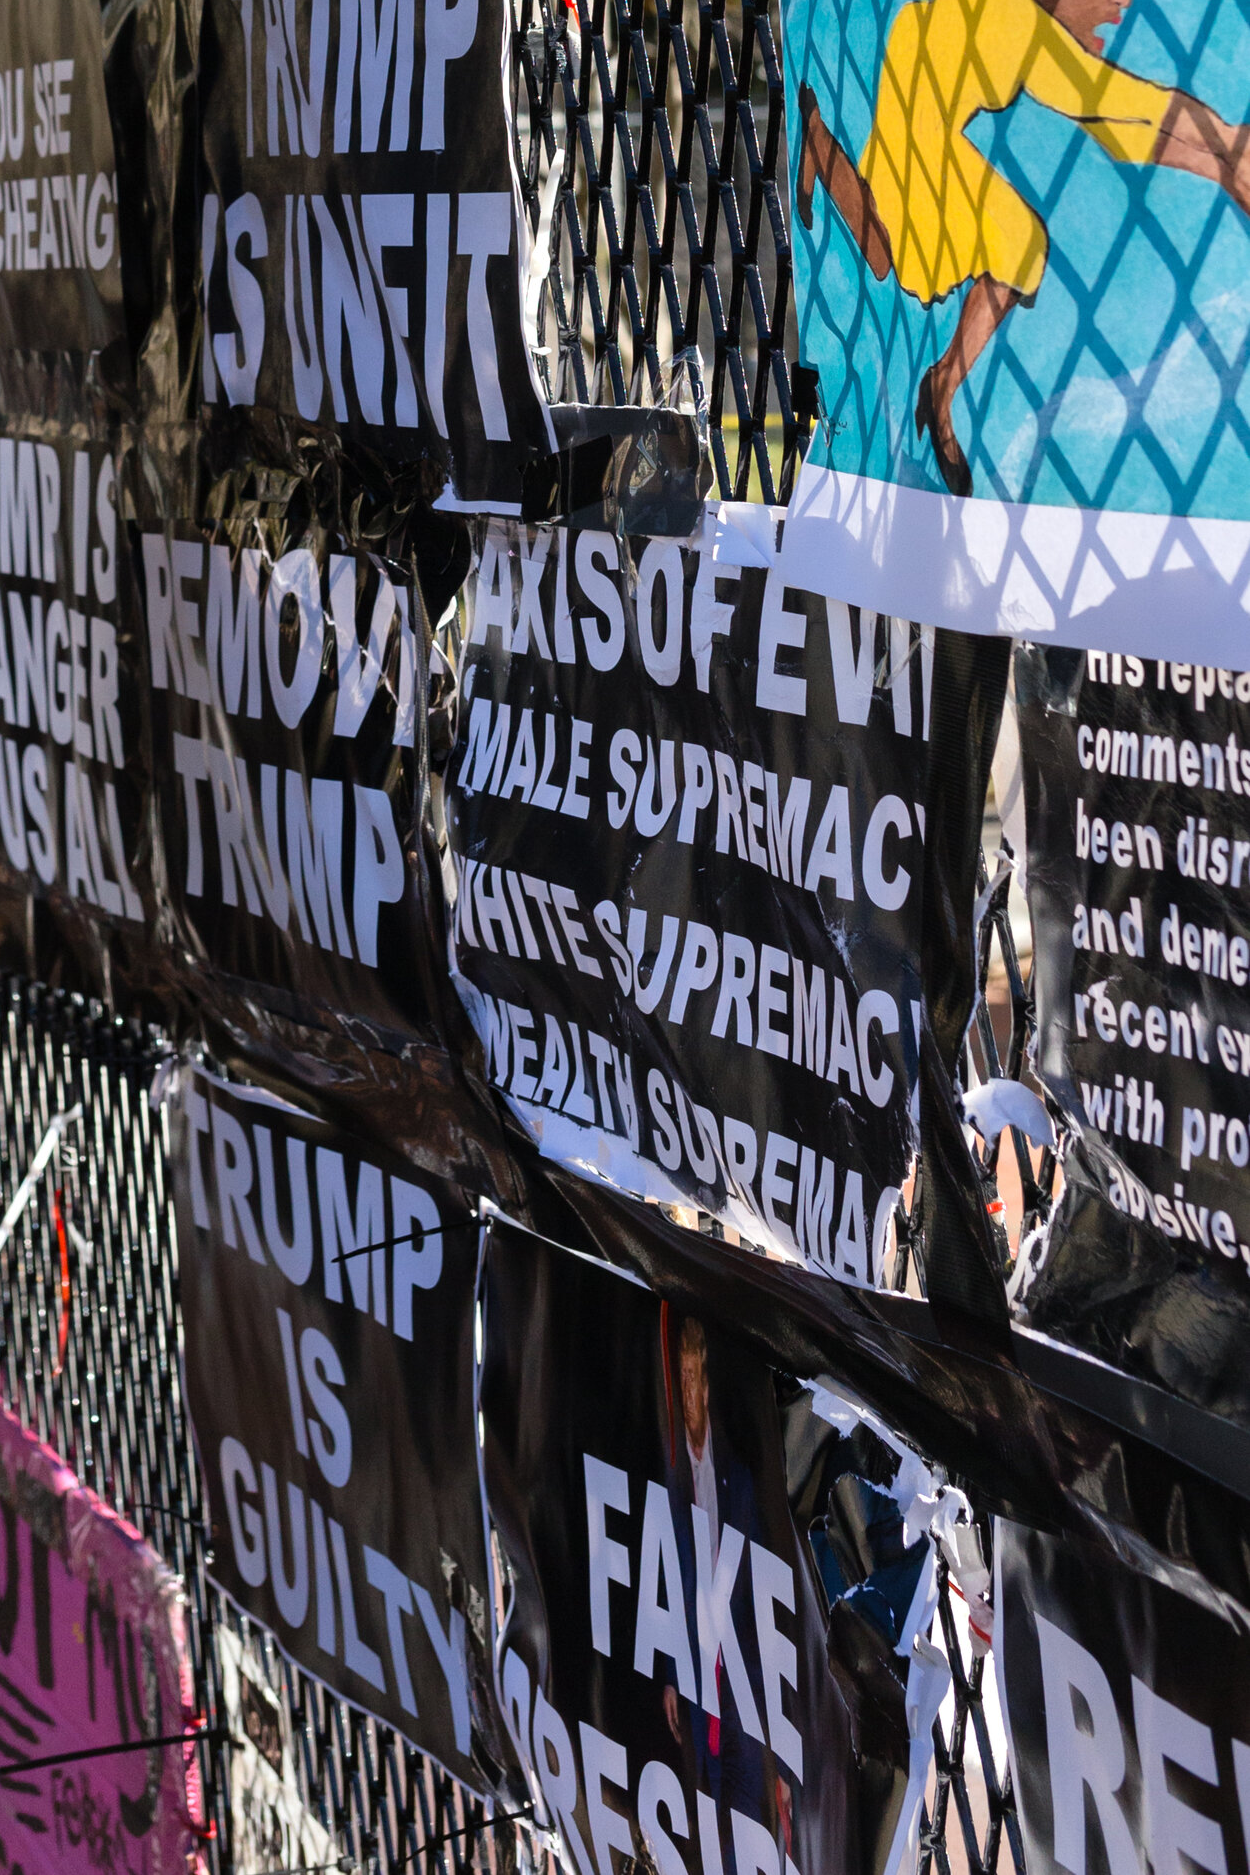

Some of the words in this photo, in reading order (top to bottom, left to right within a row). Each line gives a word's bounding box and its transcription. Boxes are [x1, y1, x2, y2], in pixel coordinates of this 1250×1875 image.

[34, 59, 75, 158] SEE
[202, 191, 268, 406] IS
[284, 191, 511, 442] UNFIT
[73, 450, 117, 605] IS
[470, 521, 626, 673] AXIS
[637, 535, 741, 694] OF
[64, 761, 144, 923] ALL
[173, 731, 405, 969] TRUMP
[458, 697, 593, 821] MALE
[606, 727, 925, 912] SUPREMAC
[1076, 797, 1164, 871] been
[454, 850, 604, 980] WHITE
[1072, 896, 1146, 959] and
[482, 992, 640, 1155] WEALTH
[1074, 991, 1210, 1064] recent
[1080, 1073, 1165, 1148] with
[182, 1072, 444, 1343] TRUMP
[276, 1306, 352, 1489] IS
[219, 1435, 472, 1757] GUILTY
[583, 1453, 804, 1786] FAKE
